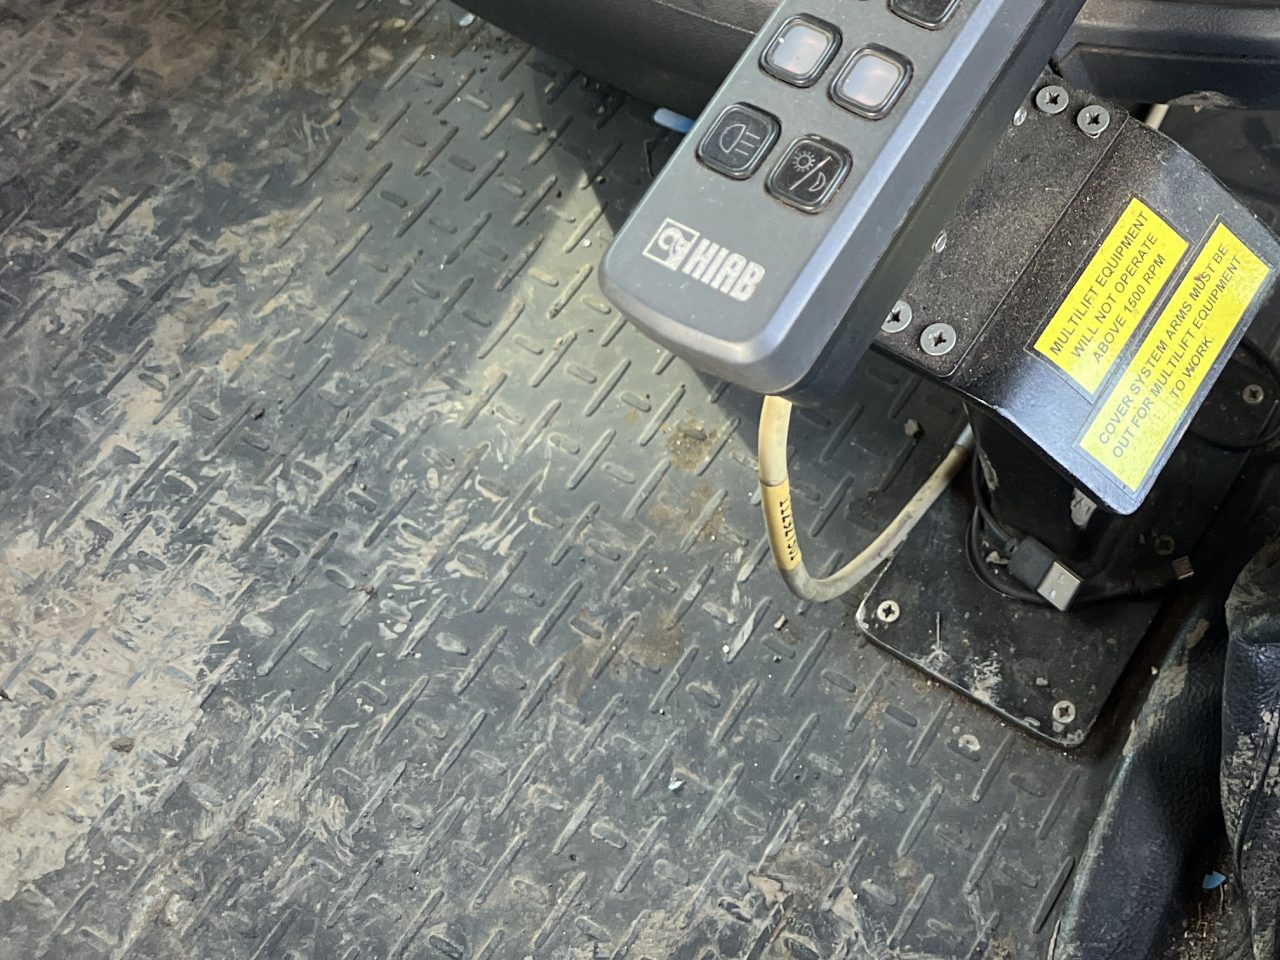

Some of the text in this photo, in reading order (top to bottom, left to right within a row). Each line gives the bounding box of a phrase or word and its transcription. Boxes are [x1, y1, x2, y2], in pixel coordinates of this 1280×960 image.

[682, 238, 766, 301] HIAB
[1048, 209, 1151, 357] MULTILIFT EQUIPMENT
[1069, 231, 1159, 359] WILL NOT OPERATE
[1089, 252, 1167, 364] ABOVE 1500 RPM
[1096, 242, 1230, 445] COVER SYSTEM ARMS MUST BE
[1109, 254, 1245, 459] OUT FOR MULTILIFT EQUIPMENT
[1168, 335, 1215, 399] TO WORK
